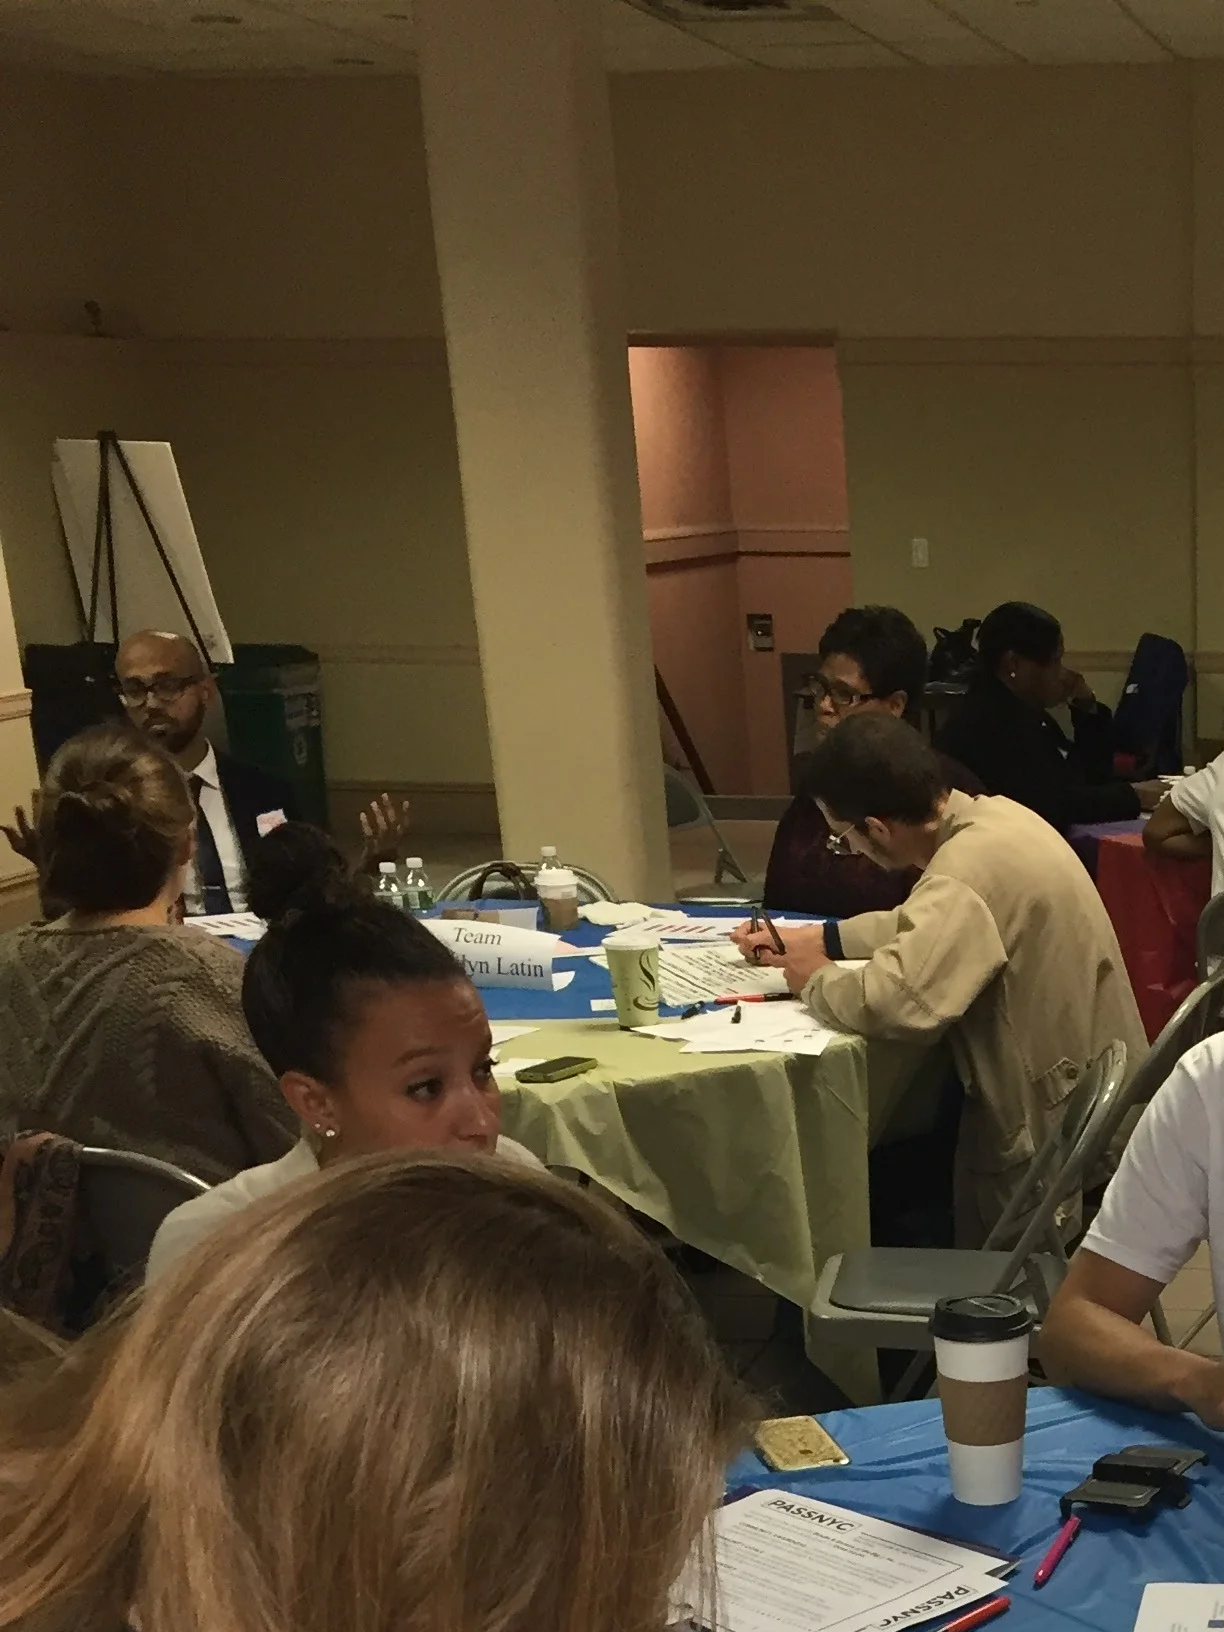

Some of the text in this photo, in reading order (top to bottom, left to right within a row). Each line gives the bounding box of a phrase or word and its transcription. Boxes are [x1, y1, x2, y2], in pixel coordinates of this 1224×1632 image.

[453, 927, 502, 945] Team
[497, 957, 544, 978] Latin
[767, 1499, 855, 1532] PASSNYC
[879, 1585, 971, 1628] PASSNYC
